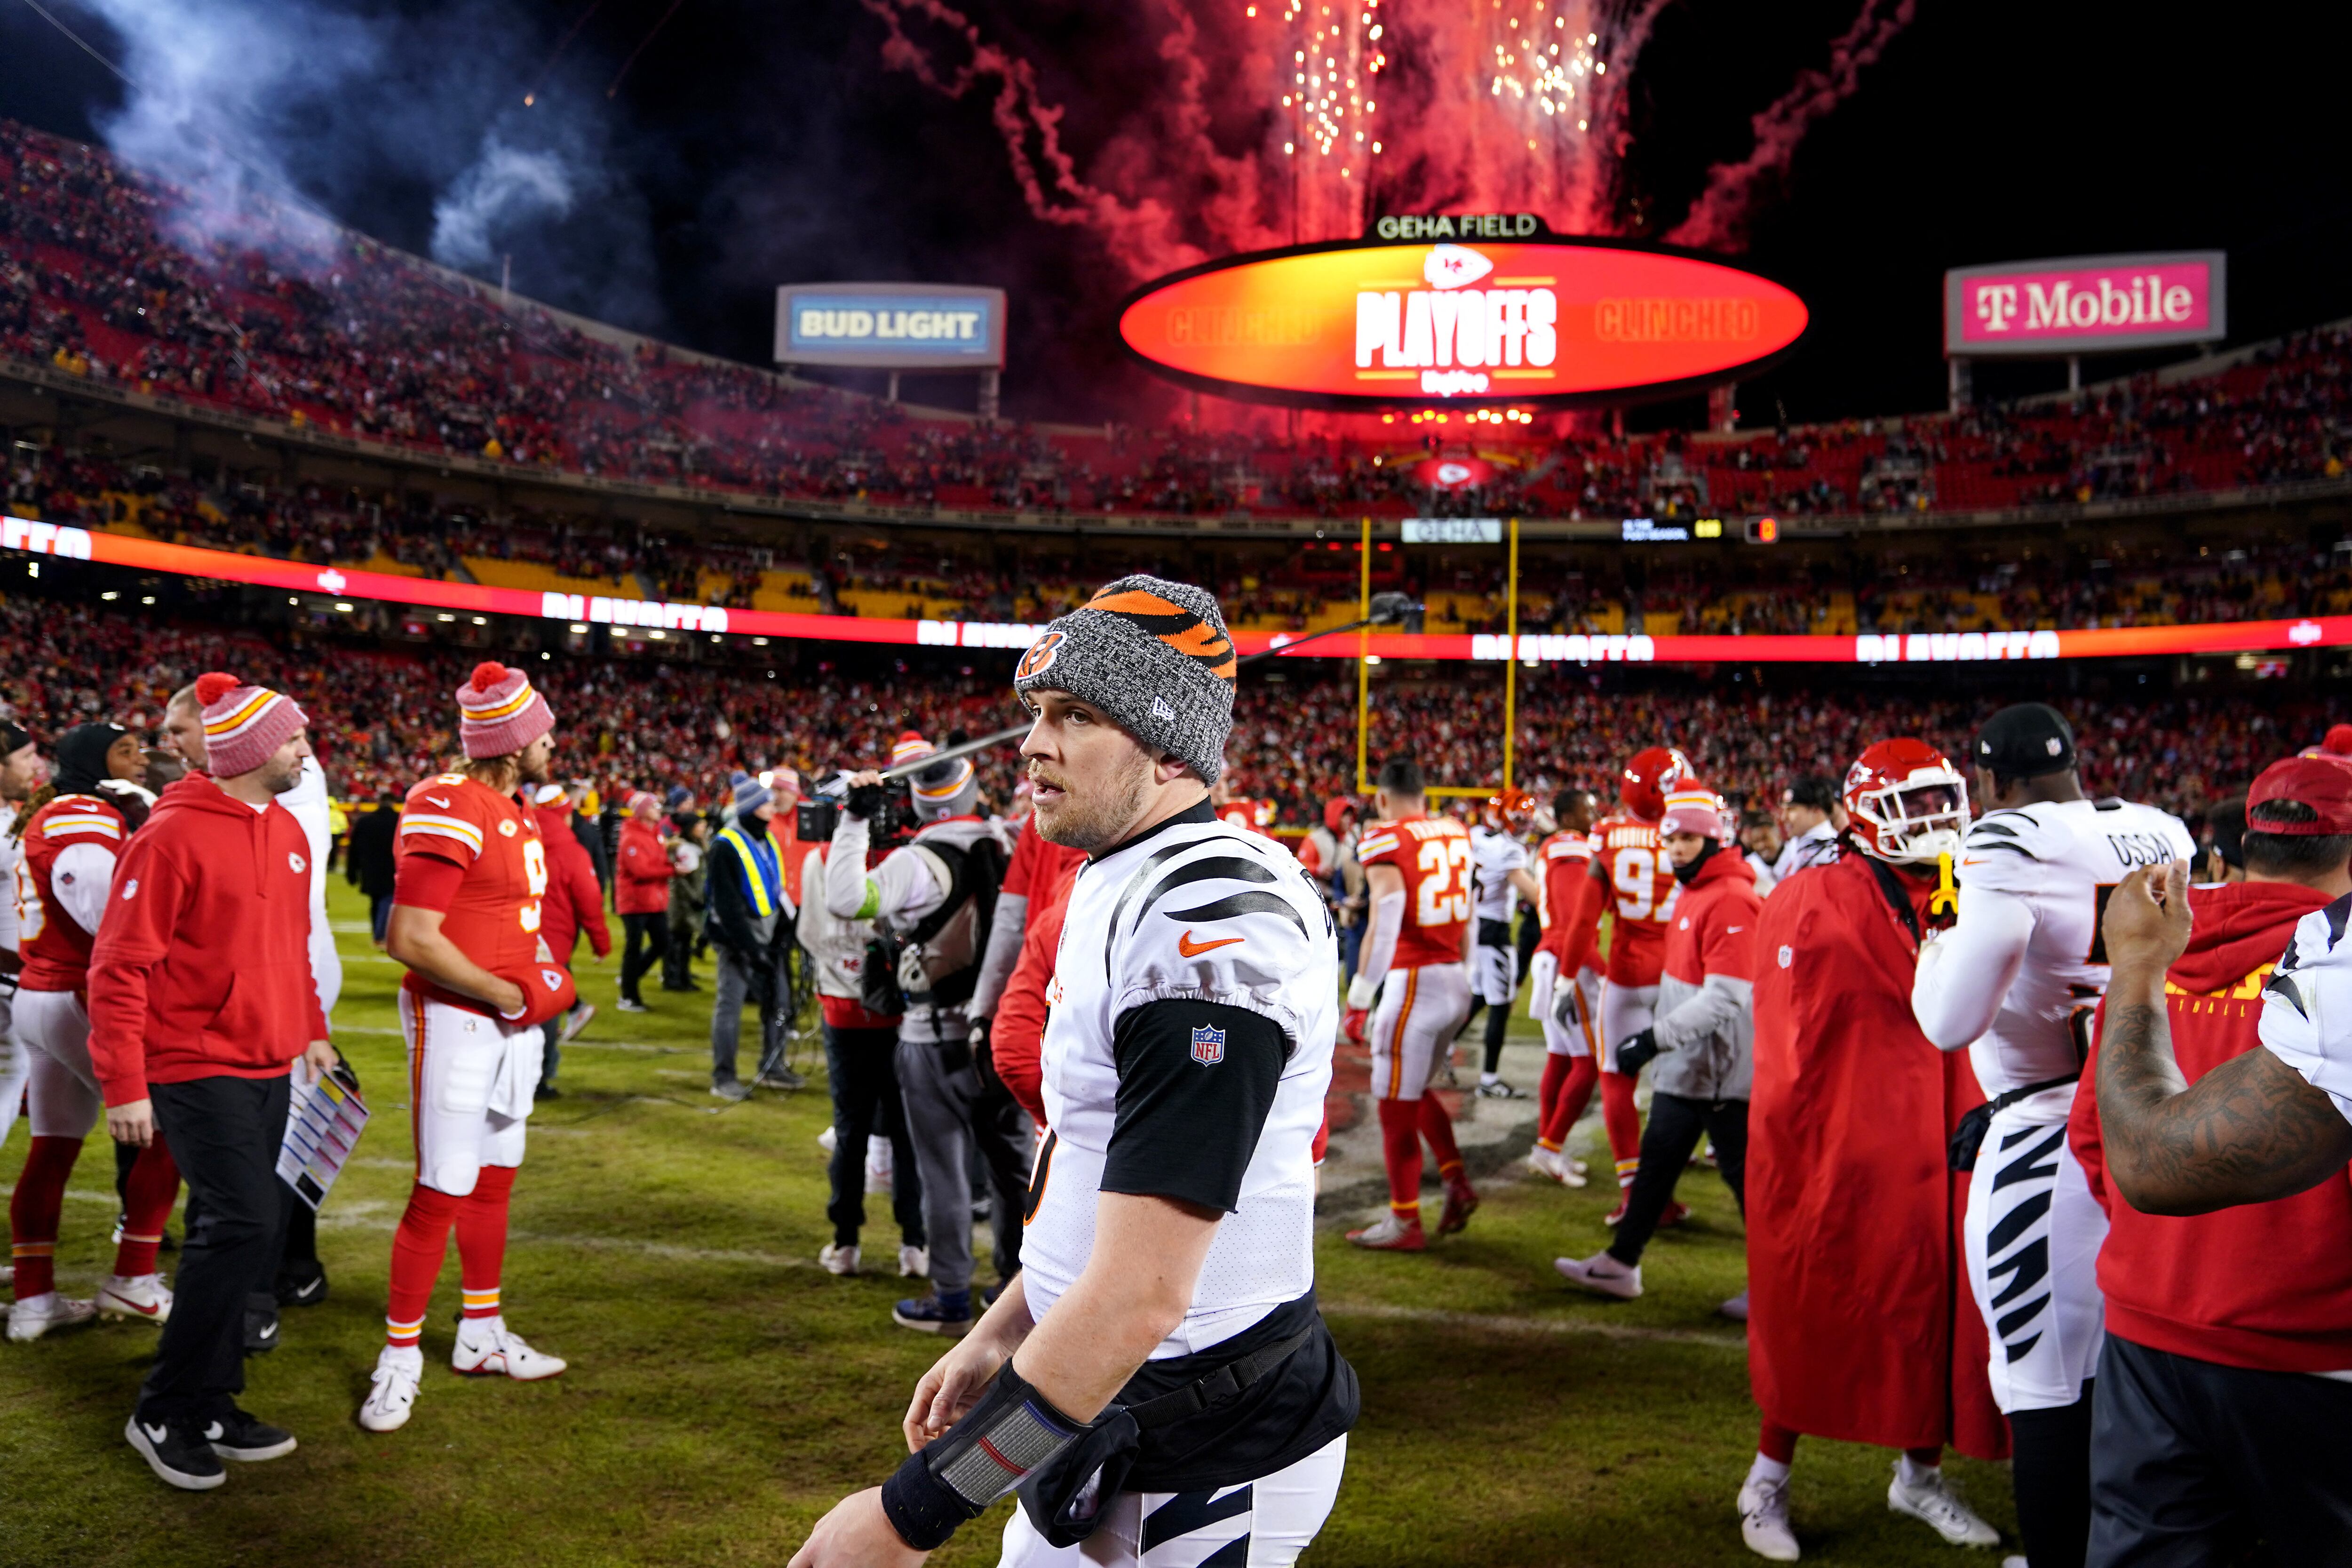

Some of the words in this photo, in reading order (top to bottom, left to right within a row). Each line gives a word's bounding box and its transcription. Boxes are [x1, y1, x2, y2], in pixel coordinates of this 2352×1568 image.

[1377, 214, 1455, 239] GEHA
[1460, 213, 1538, 238] FIELD
[1598, 300, 1757, 340] CLINCHED
[2025, 275, 2193, 329] Mobile
[800, 309, 874, 338] BUD
[876, 310, 979, 340] LIGHT
[1355, 287, 1557, 367] PLAYOFFS
[2107, 831, 2176, 866] OSSAI
[1416, 837, 1474, 927] 23
[1613, 847, 1683, 923] 97
[1195, 1042, 1220, 1061] NFL
